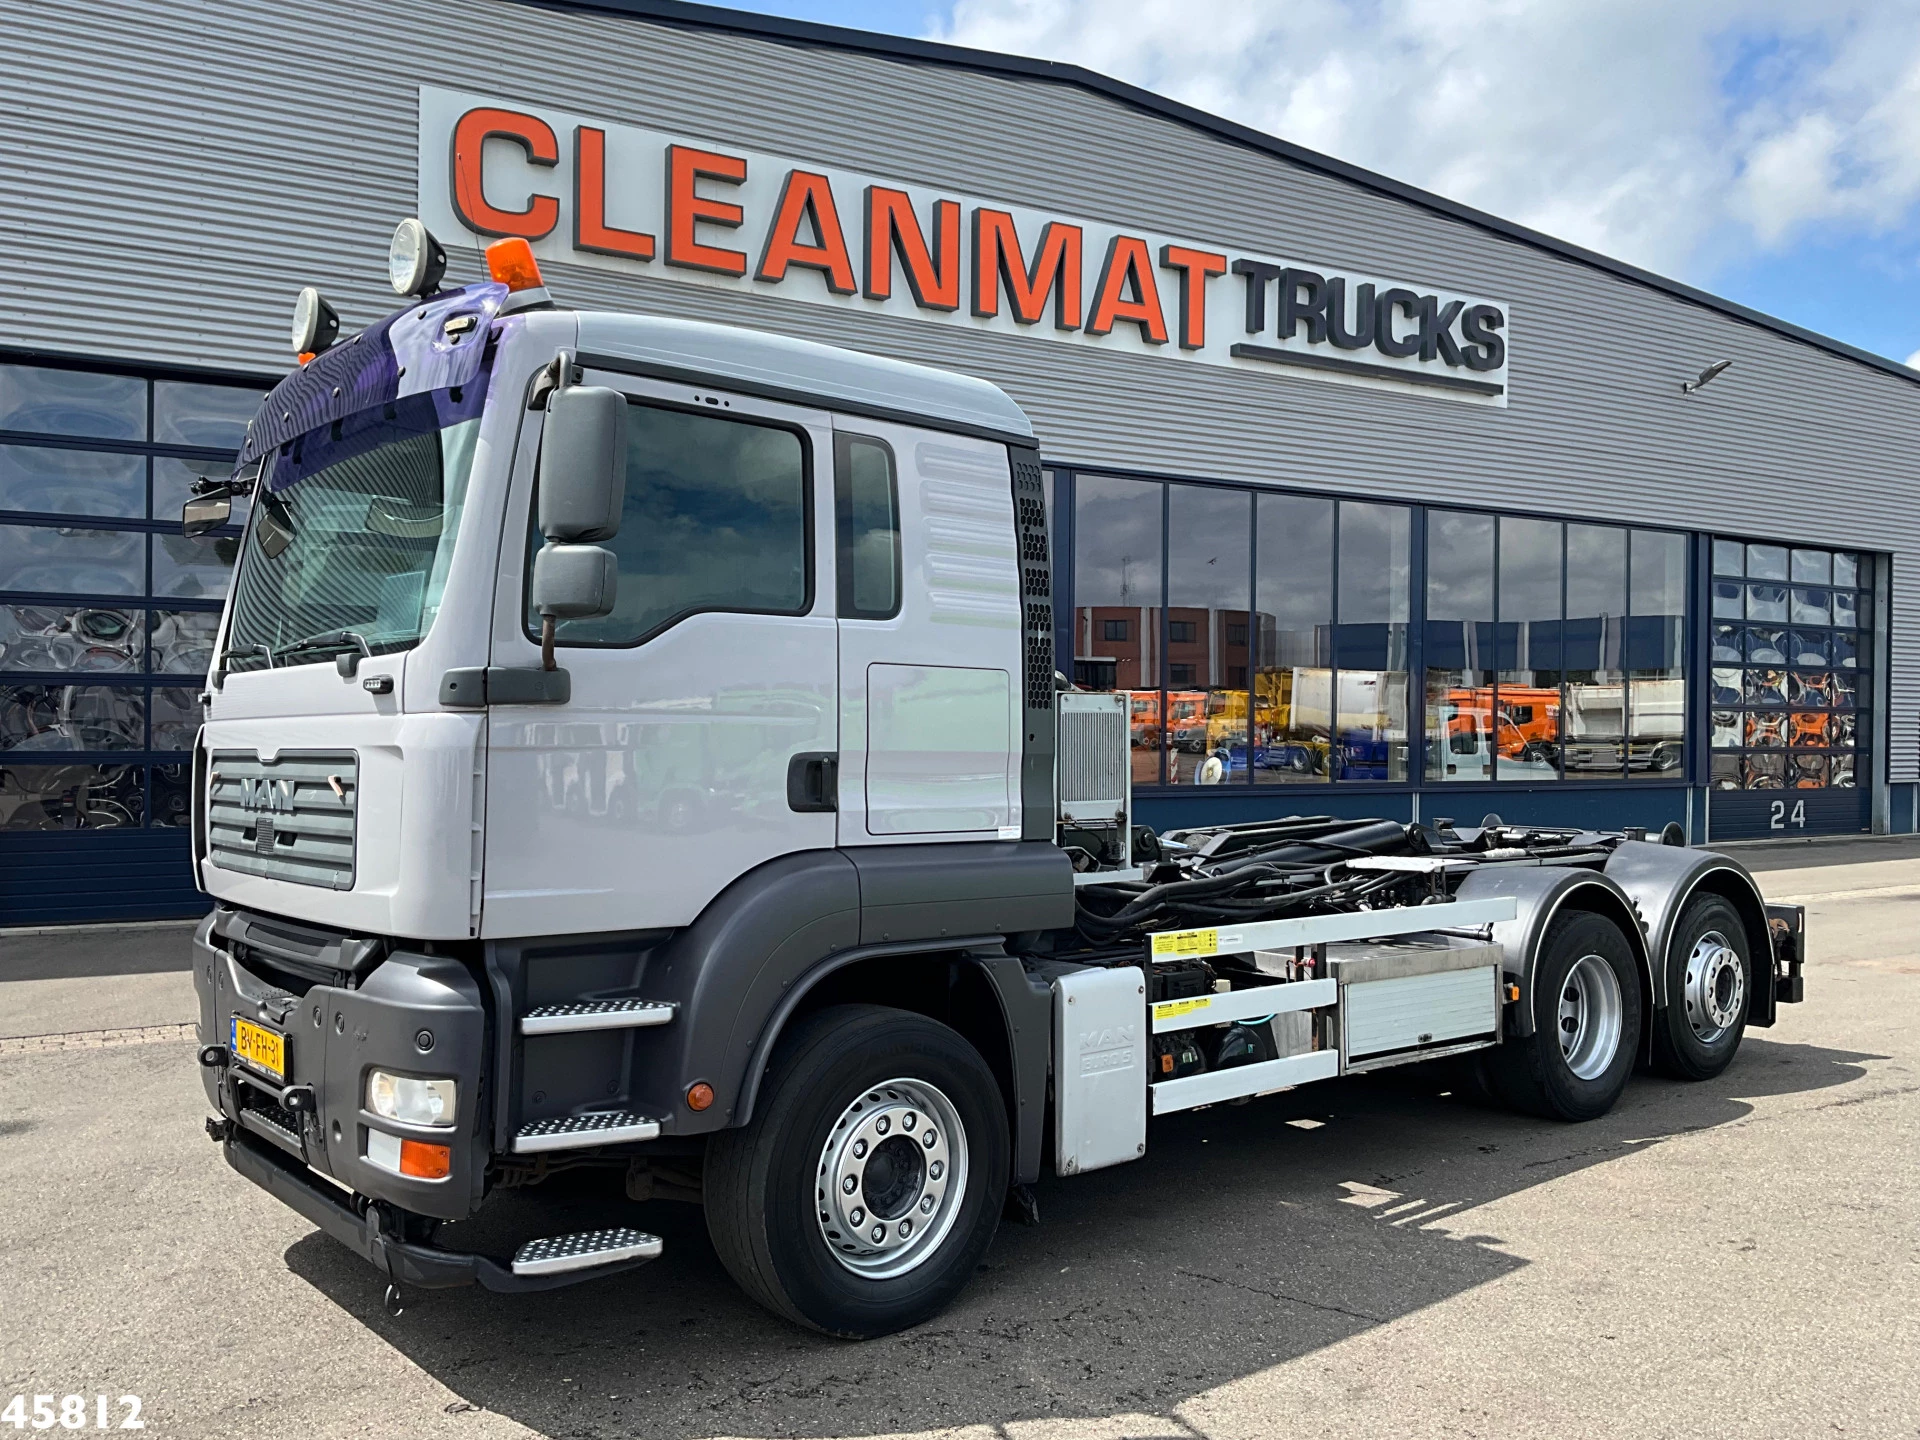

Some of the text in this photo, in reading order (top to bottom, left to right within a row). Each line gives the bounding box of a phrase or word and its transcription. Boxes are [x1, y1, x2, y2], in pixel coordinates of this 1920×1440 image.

[449, 106, 1505, 372] CLEANMAT TRUCKS
[240, 778, 295, 812] MAN
[1770, 799, 1806, 829] 24
[1079, 1024, 1134, 1051] MAN
[1081, 1049, 1133, 1072] EURO 5
